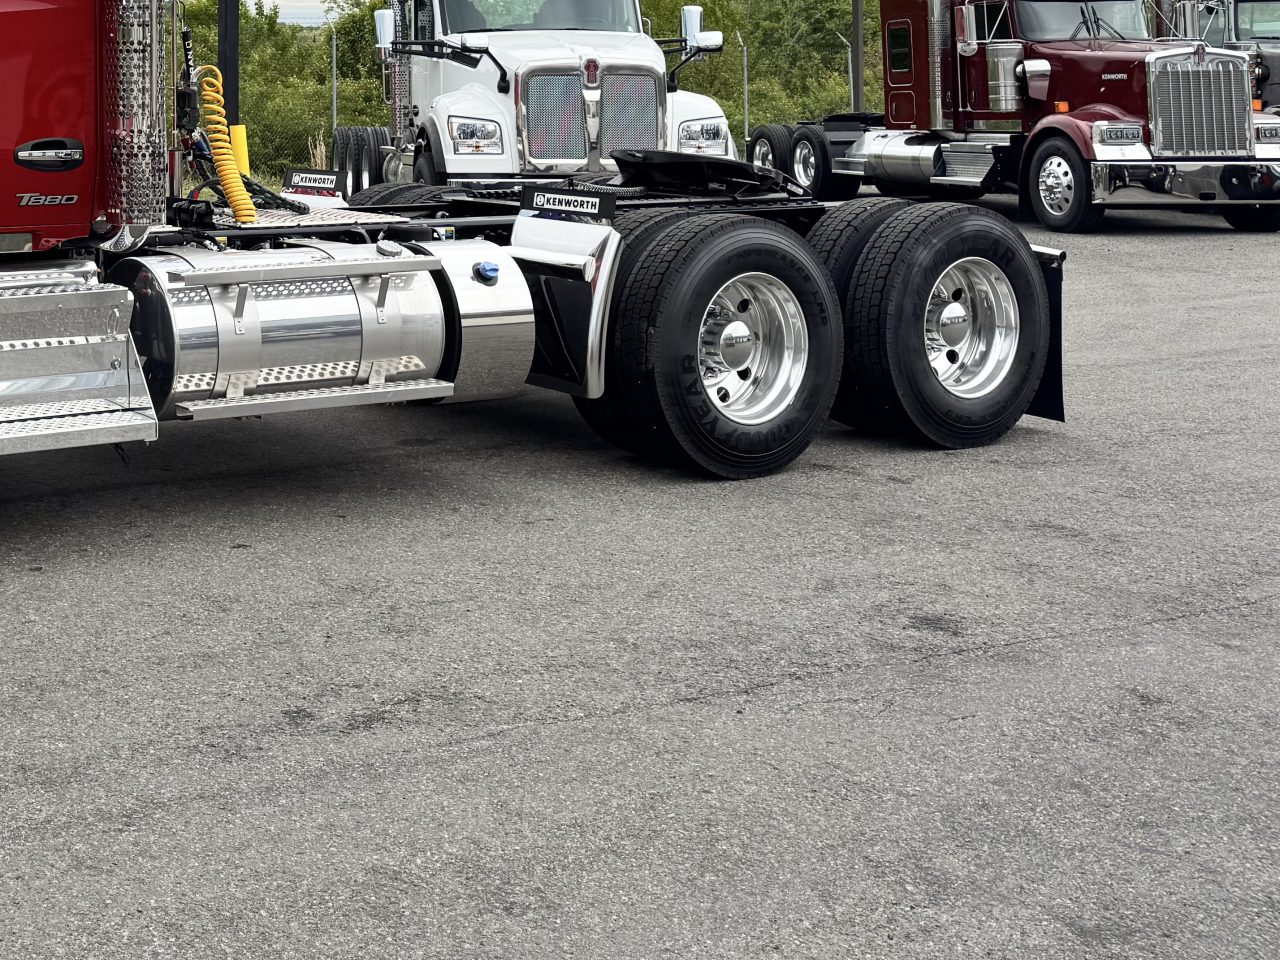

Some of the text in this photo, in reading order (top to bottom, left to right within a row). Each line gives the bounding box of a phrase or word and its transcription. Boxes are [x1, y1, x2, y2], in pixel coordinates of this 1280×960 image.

[300, 176, 335, 185] KENWORTH
[15, 192, 79, 206] T880
[546, 196, 597, 210] KENWORTH
